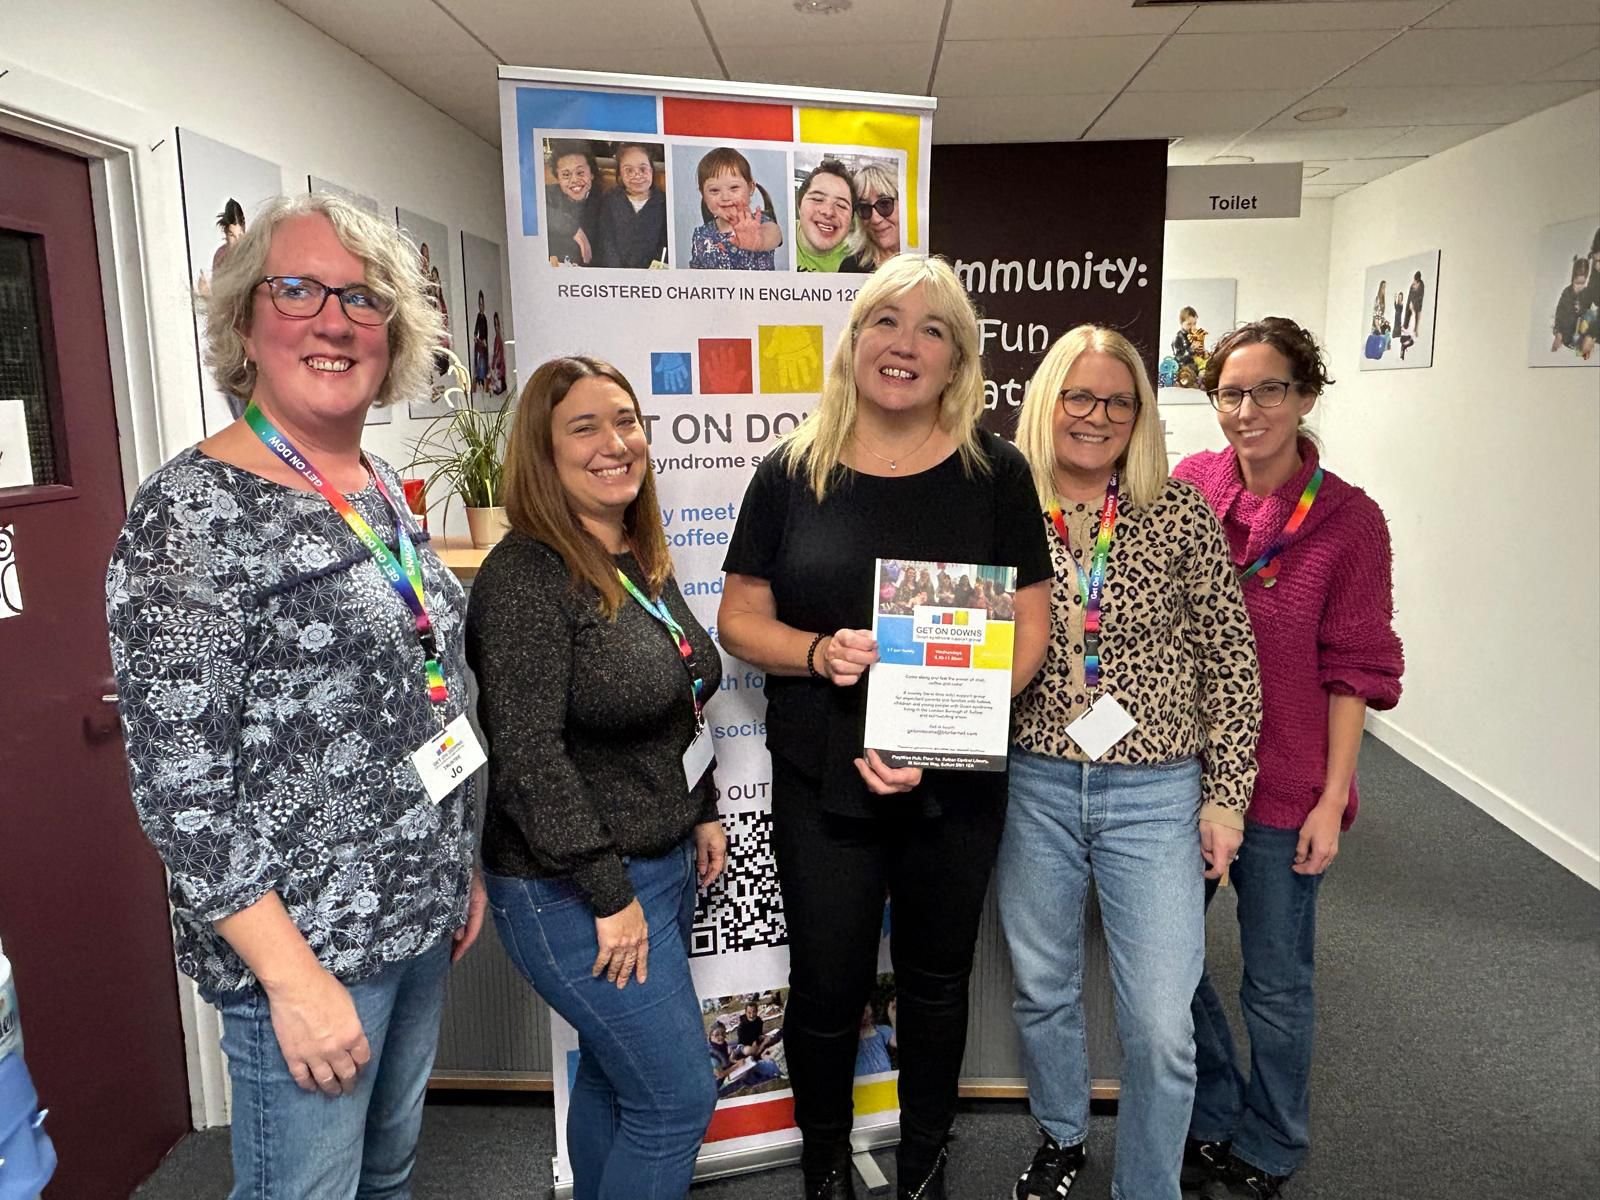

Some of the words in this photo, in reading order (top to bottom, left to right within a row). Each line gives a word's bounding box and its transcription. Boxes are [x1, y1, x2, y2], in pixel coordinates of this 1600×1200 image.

[1210, 195, 1258, 211] Toilet
[954, 251, 1148, 294] mmunity:
[558, 284, 662, 298] REGISTERED
[666, 286, 736, 300] CHARITY
[740, 288, 754, 300] IN
[760, 288, 832, 302] ENGLAND
[976, 318, 1049, 356] Fun
[672, 413, 732, 444] ON
[288, 455, 306, 470] ON
[650, 454, 745, 474] syndrome
[302, 470, 323, 487] GET
[681, 502, 736, 522] meet
[373, 548, 387, 563] ON
[382, 564, 400, 582] GET
[684, 577, 723, 596] and
[935, 627, 948, 635] ON
[950, 628, 982, 637] DOWNS
[744, 672, 764, 688] fo
[714, 720, 767, 739] socia
[728, 782, 770, 800] OUT
